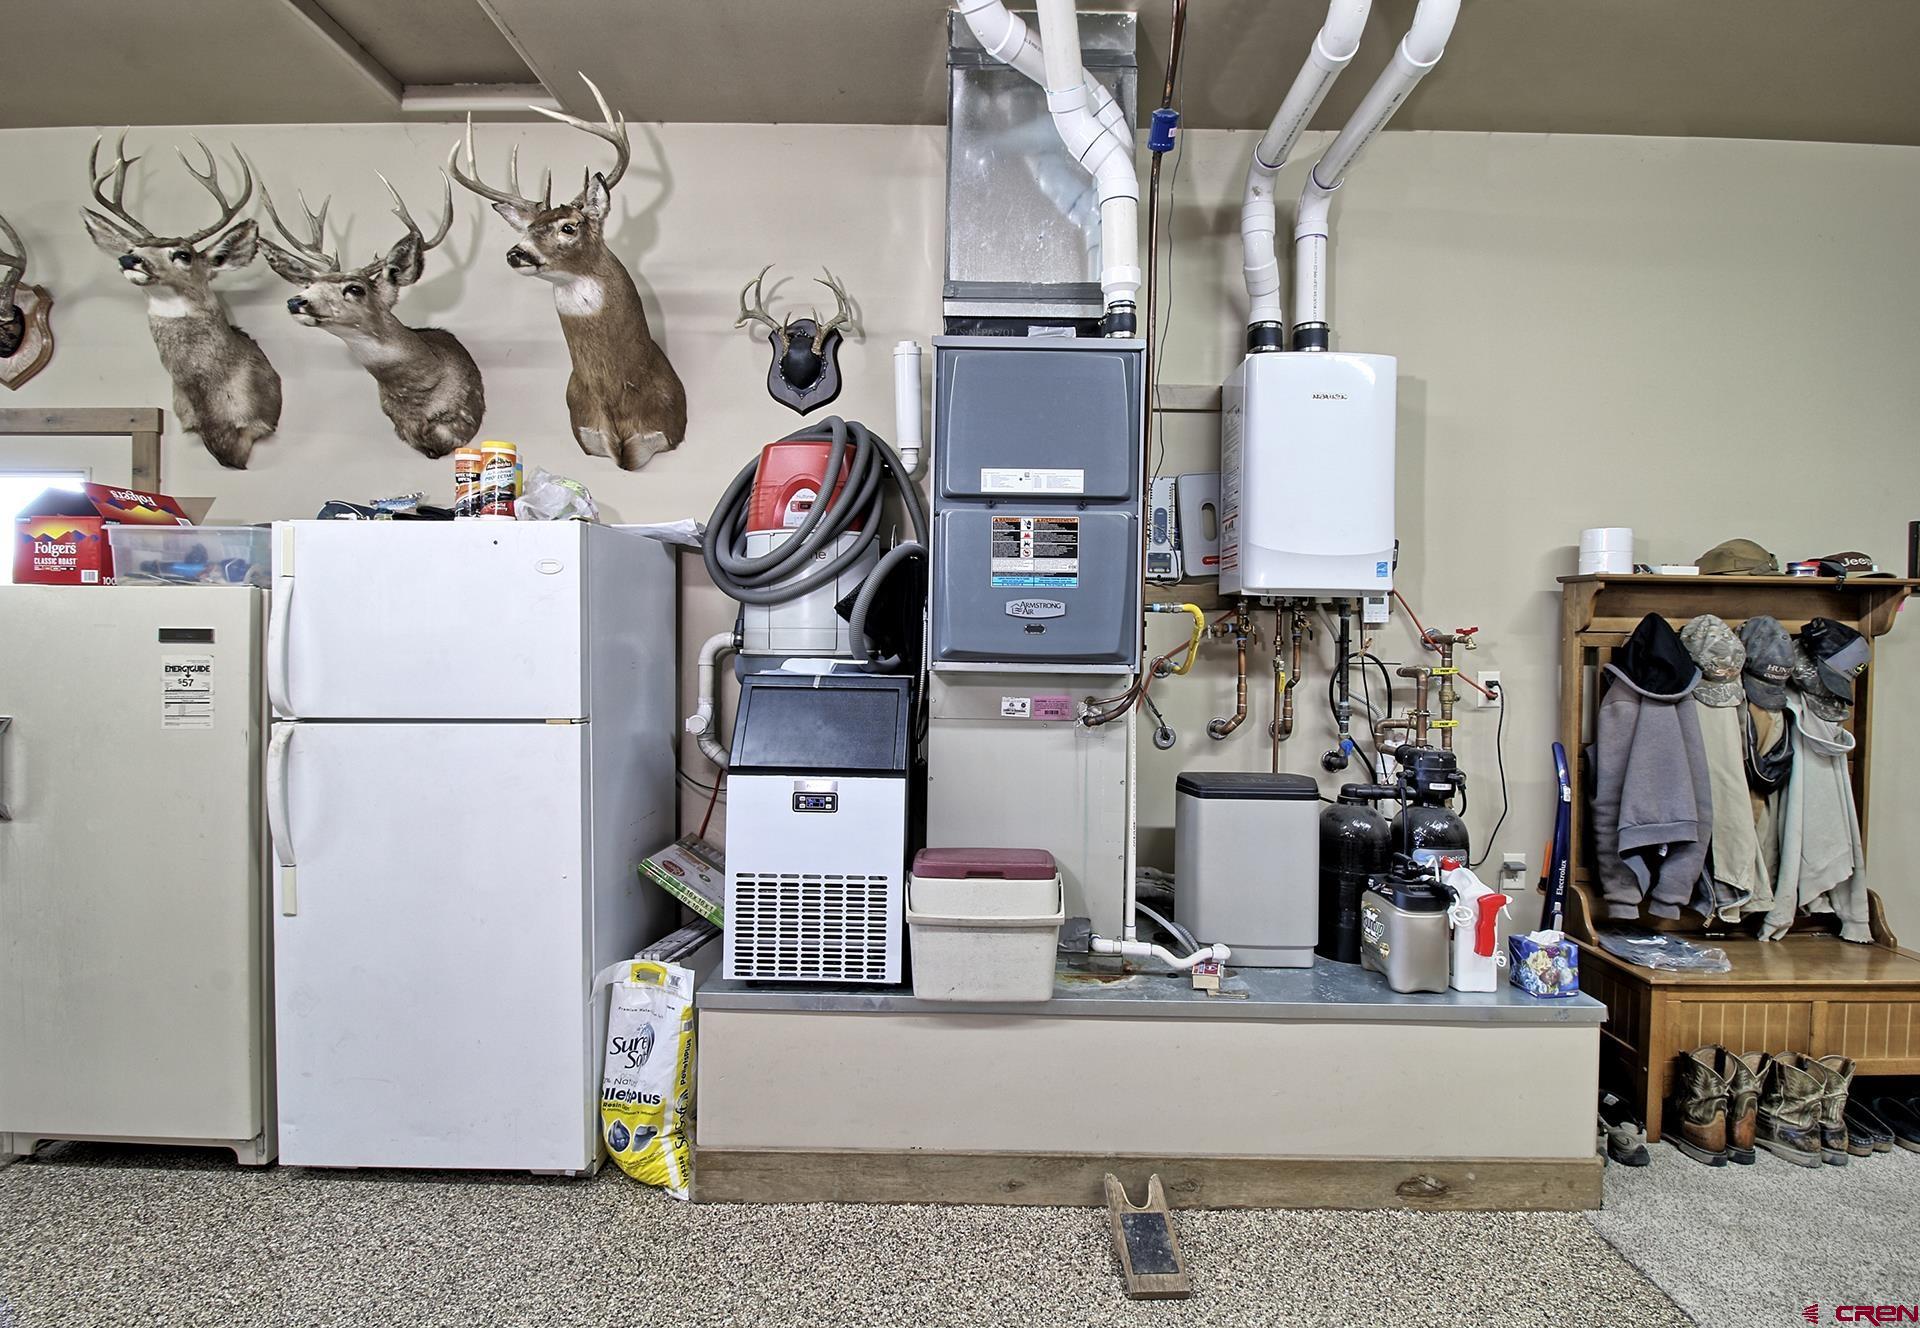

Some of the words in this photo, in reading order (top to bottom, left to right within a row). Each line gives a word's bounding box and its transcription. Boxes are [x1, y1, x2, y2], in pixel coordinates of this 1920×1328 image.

[109, 489, 157, 507] Folgers
[34, 541, 76, 557] Folgers
[34, 557, 57, 565] CLASSIC
[59, 557, 76, 565] ROAST
[1841, 557, 1873, 567] Jeep
[1020, 601, 1061, 609] ARMSTRONG
[177, 678, 194, 687] $57
[1555, 860, 1567, 896] Electrolux
